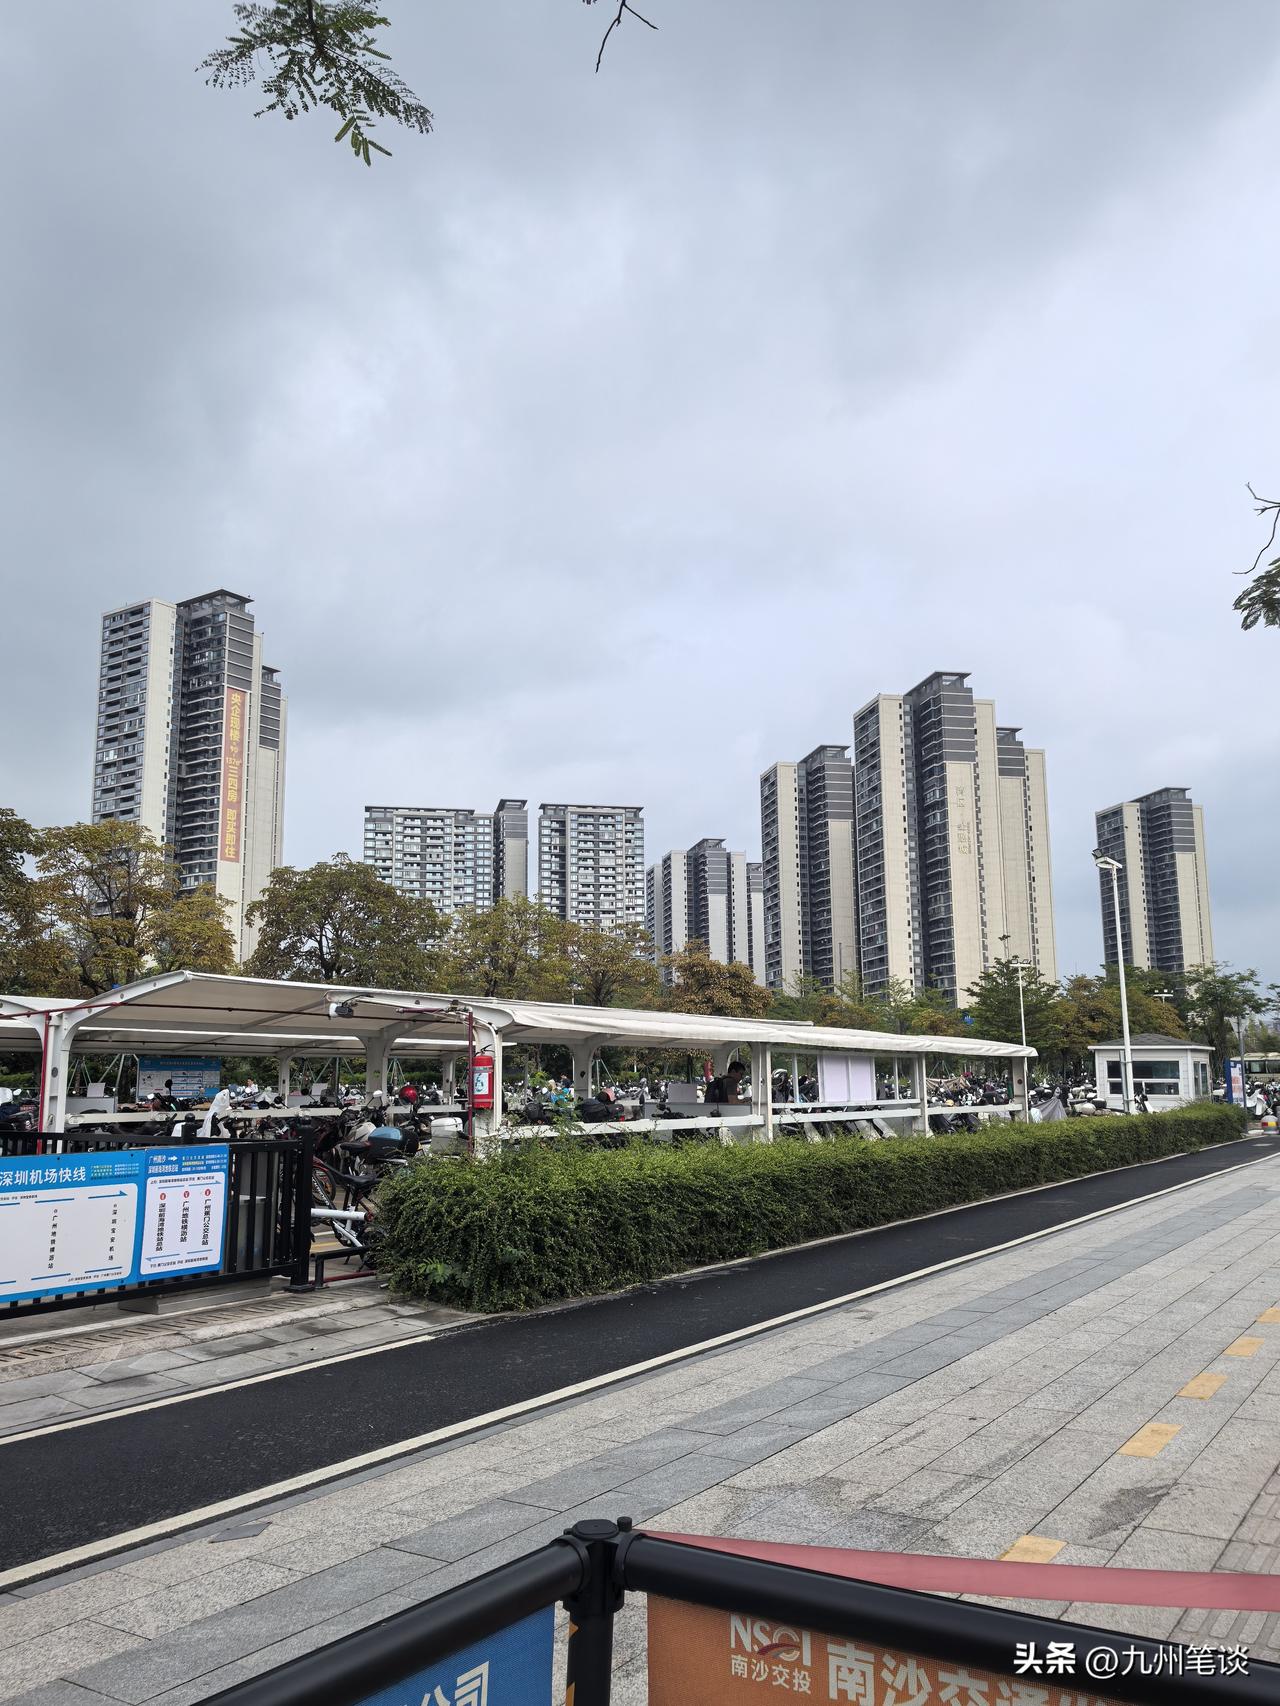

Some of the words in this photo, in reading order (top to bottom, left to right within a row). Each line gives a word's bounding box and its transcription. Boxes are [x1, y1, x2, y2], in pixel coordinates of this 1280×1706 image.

[0, 1166, 87, 1187] 深圳机场快线
[731, 1653, 812, 1695] 南沙交投
